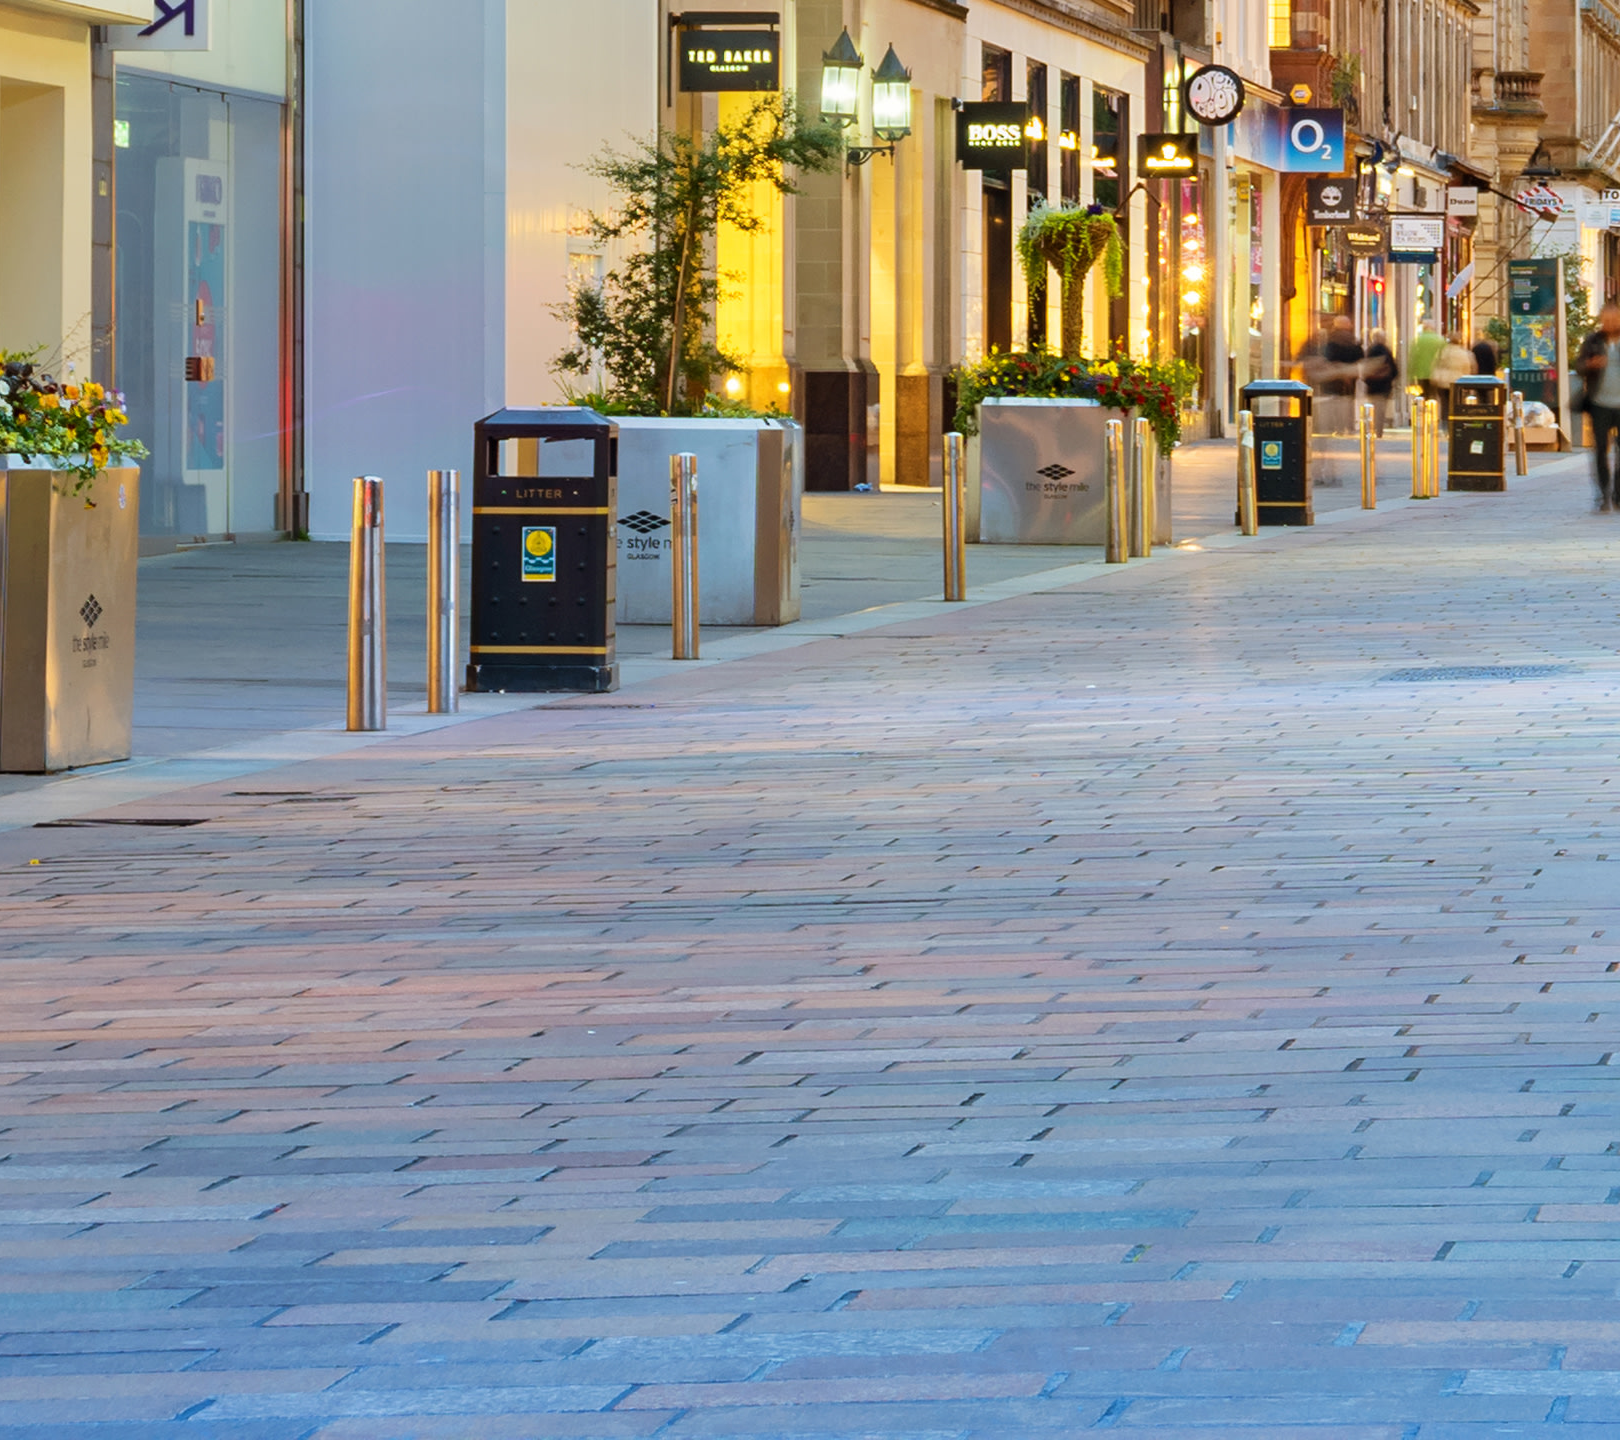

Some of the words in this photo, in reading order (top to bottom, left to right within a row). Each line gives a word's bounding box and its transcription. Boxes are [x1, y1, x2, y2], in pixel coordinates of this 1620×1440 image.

[688, 50, 716, 63] TED
[723, 50, 772, 64] BAKER
[968, 124, 1021, 140] BOSS
[1291, 119, 1332, 160] O2
[1604, 190, 1620, 199] TO
[516, 489, 563, 499] LITTER
[1043, 482, 1068, 493] style
[627, 536, 660, 552] style
